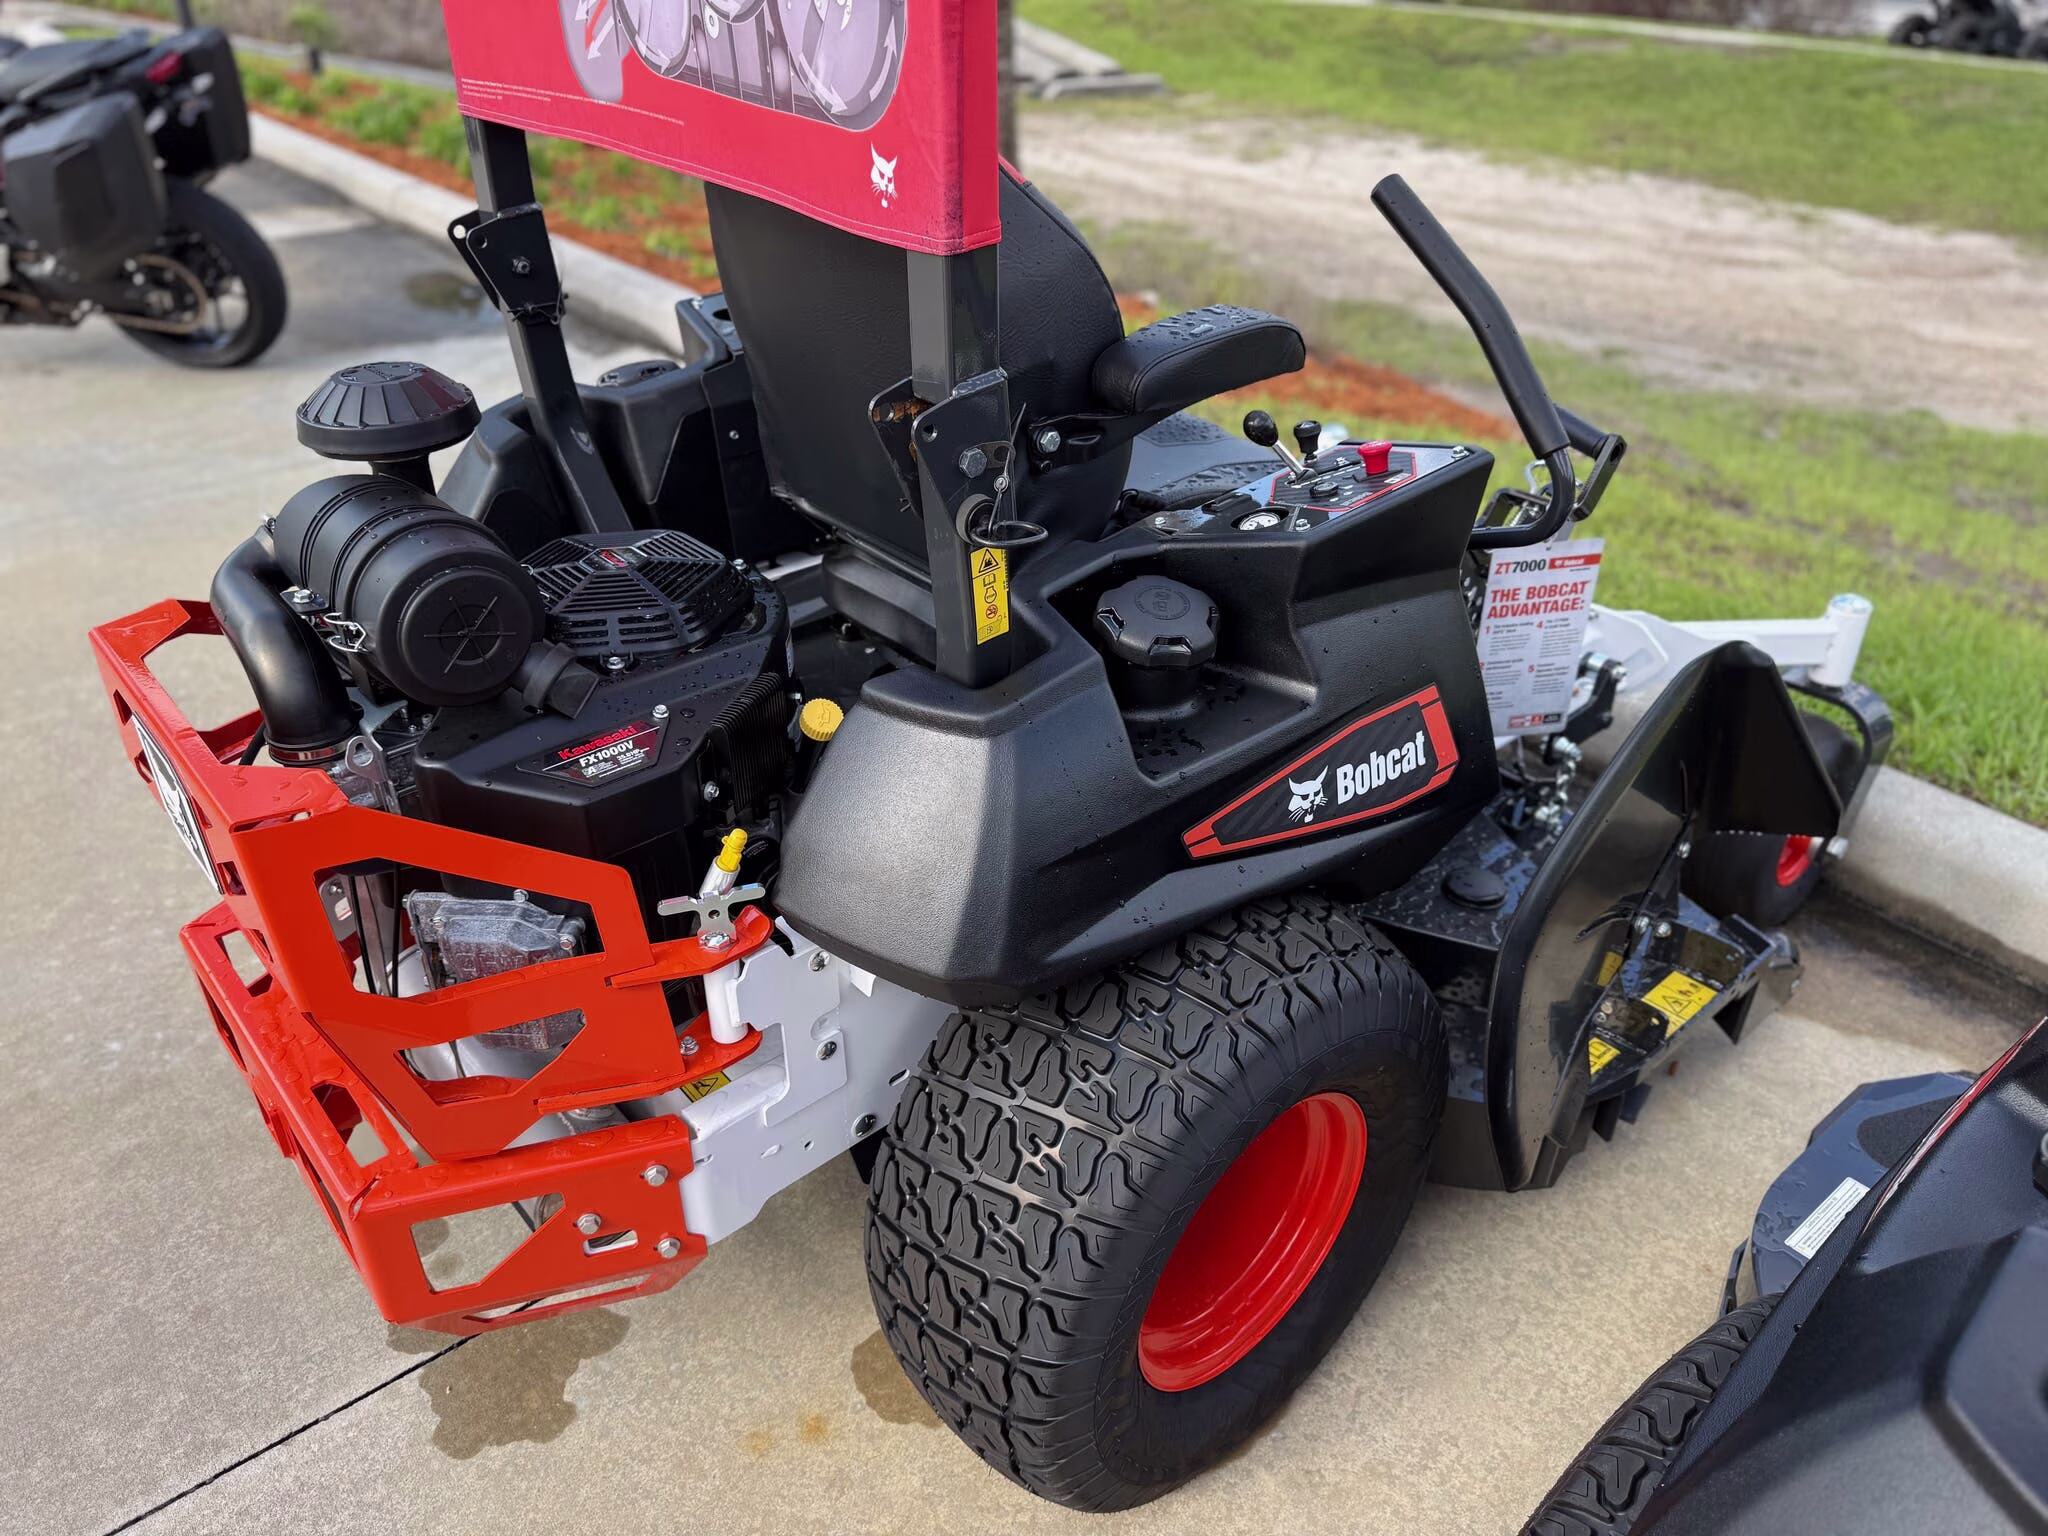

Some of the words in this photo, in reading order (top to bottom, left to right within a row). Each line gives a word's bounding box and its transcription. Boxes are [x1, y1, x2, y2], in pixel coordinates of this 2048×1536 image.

[1494, 558, 1546, 575] ZT7000
[1491, 587, 1522, 603] THE
[1525, 580, 1590, 601] BOBCAT
[1487, 599, 1585, 619] ADVANTAGE:
[1536, 620, 1544, 630] 4
[1528, 664, 1535, 673] 5
[557, 725, 638, 761] Kawasaki
[578, 740, 634, 768] FX1000V
[1336, 730, 1426, 805] Bobcat
